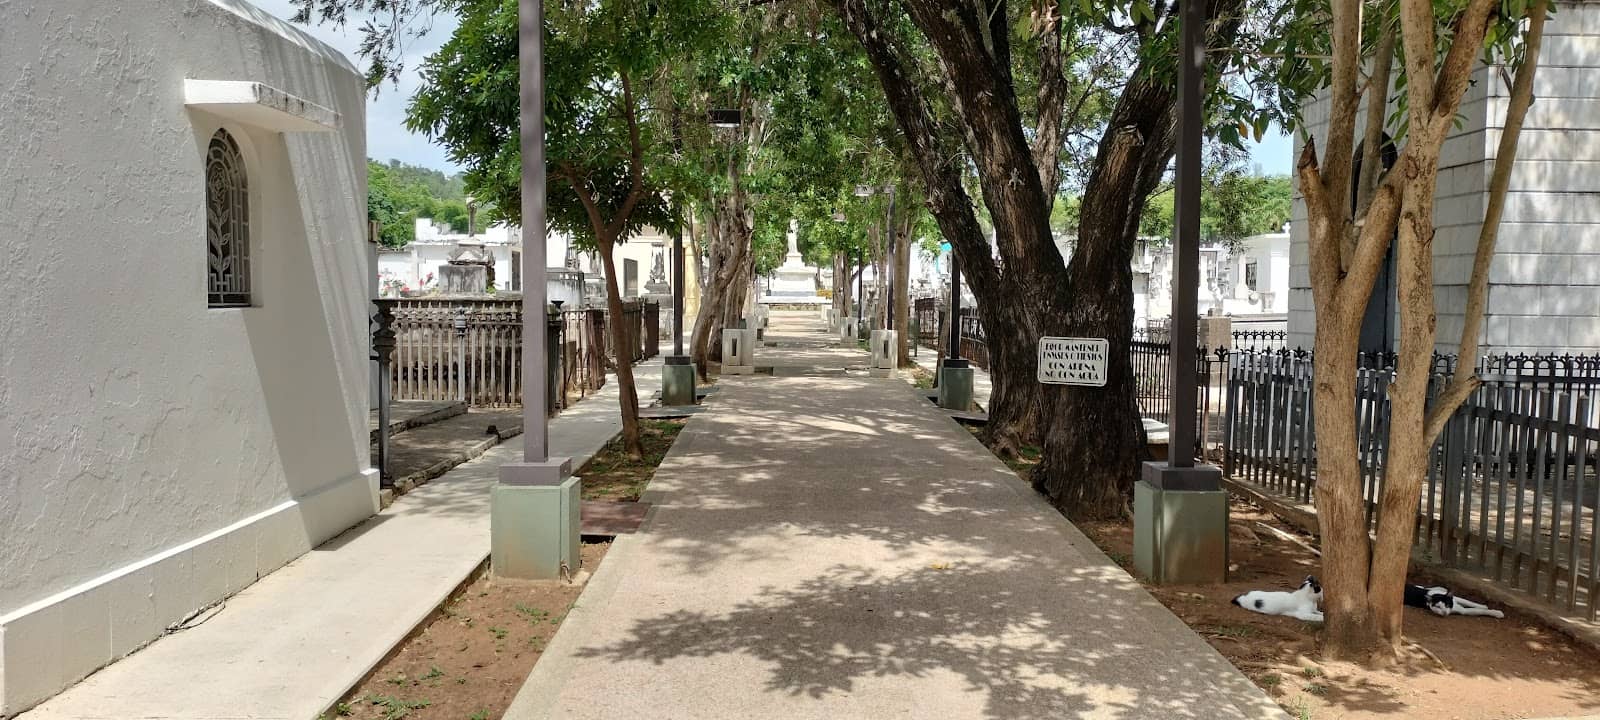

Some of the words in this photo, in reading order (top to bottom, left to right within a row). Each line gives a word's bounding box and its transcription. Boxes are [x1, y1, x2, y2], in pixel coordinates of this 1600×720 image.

[1065, 343, 1101, 352] MANTENER
[1043, 351, 1069, 360] ENVASES
[1076, 352, 1103, 361] TIESTOS
[1048, 362, 1065, 370] CON
[1067, 362, 1096, 371] ARENA
[1058, 371, 1075, 379] CON
[1078, 372, 1099, 380] AGUA
